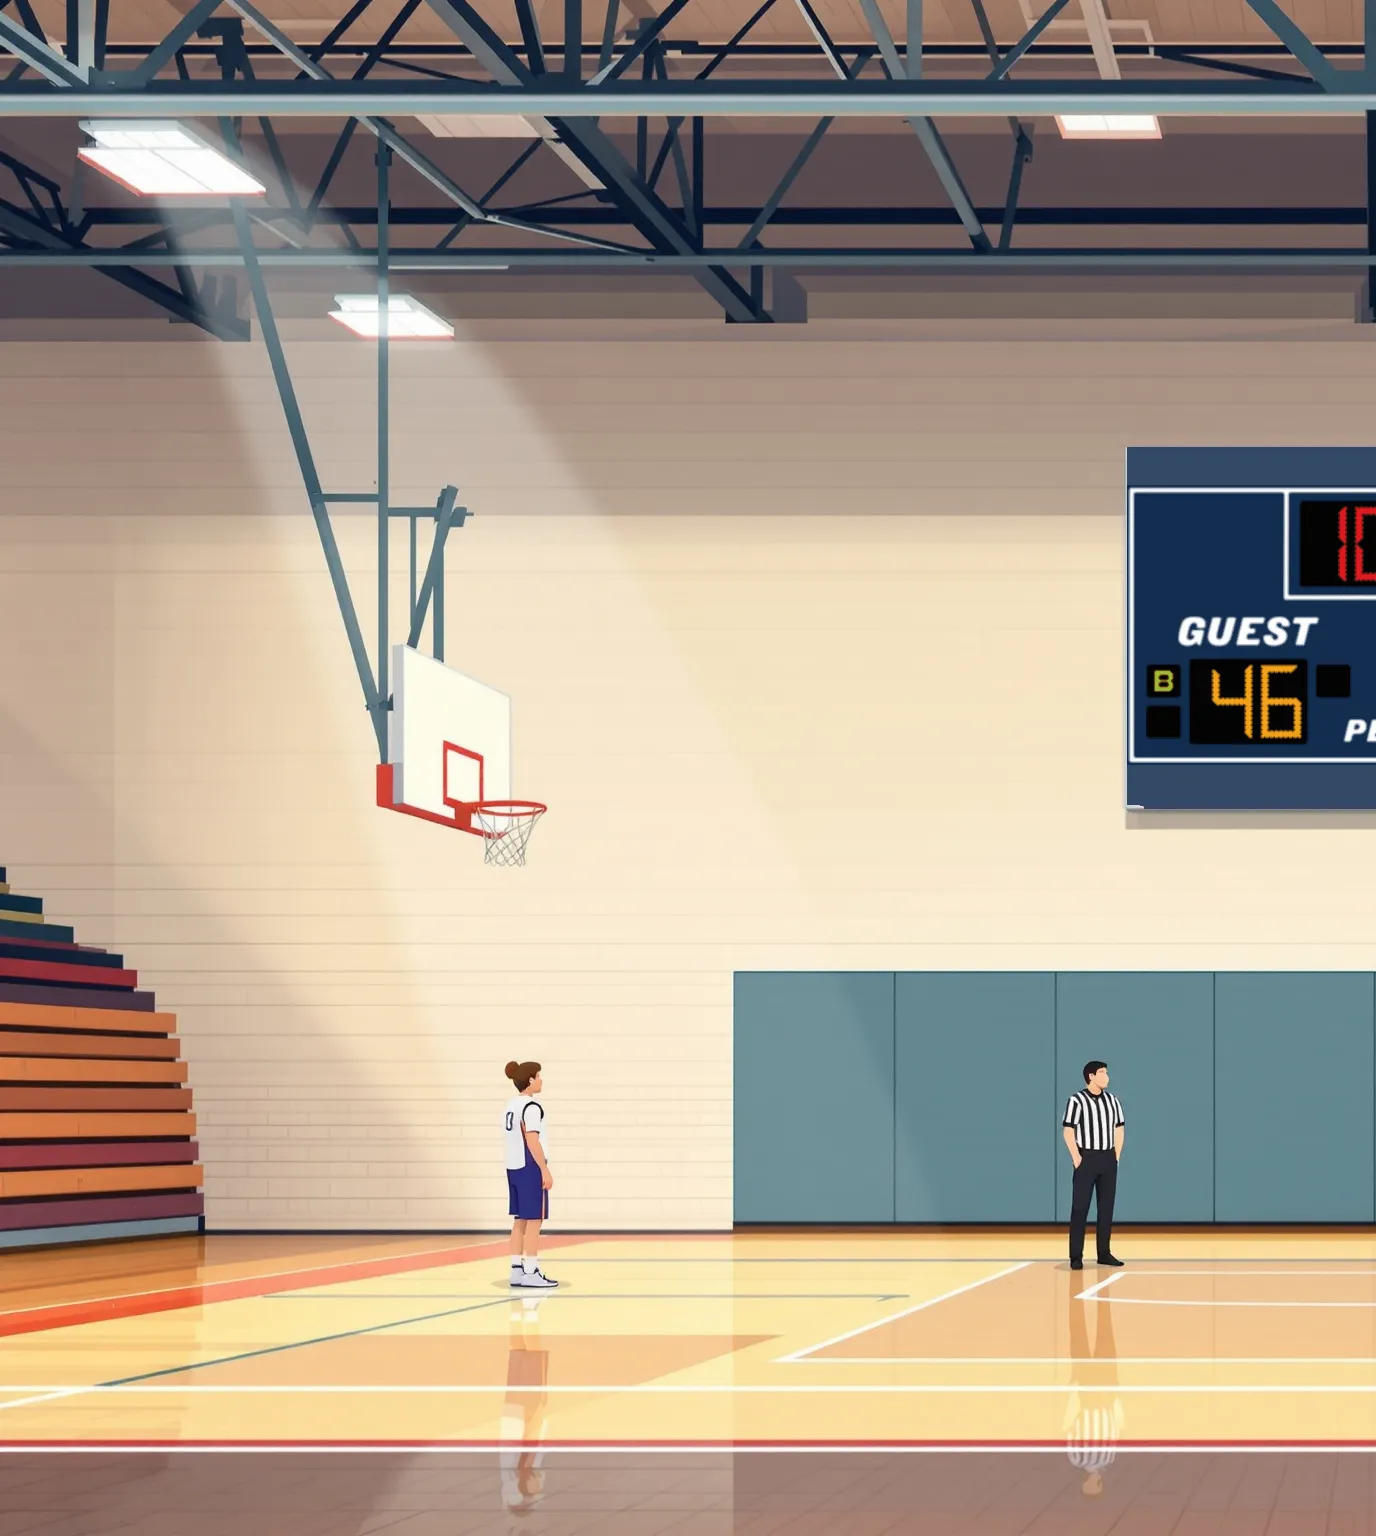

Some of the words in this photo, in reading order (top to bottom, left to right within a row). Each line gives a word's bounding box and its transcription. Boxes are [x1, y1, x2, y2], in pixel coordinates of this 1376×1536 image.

[1178, 617, 1320, 646] GUEST
[1154, 671, 1174, 692] B
[1211, 665, 1302, 738] 46
